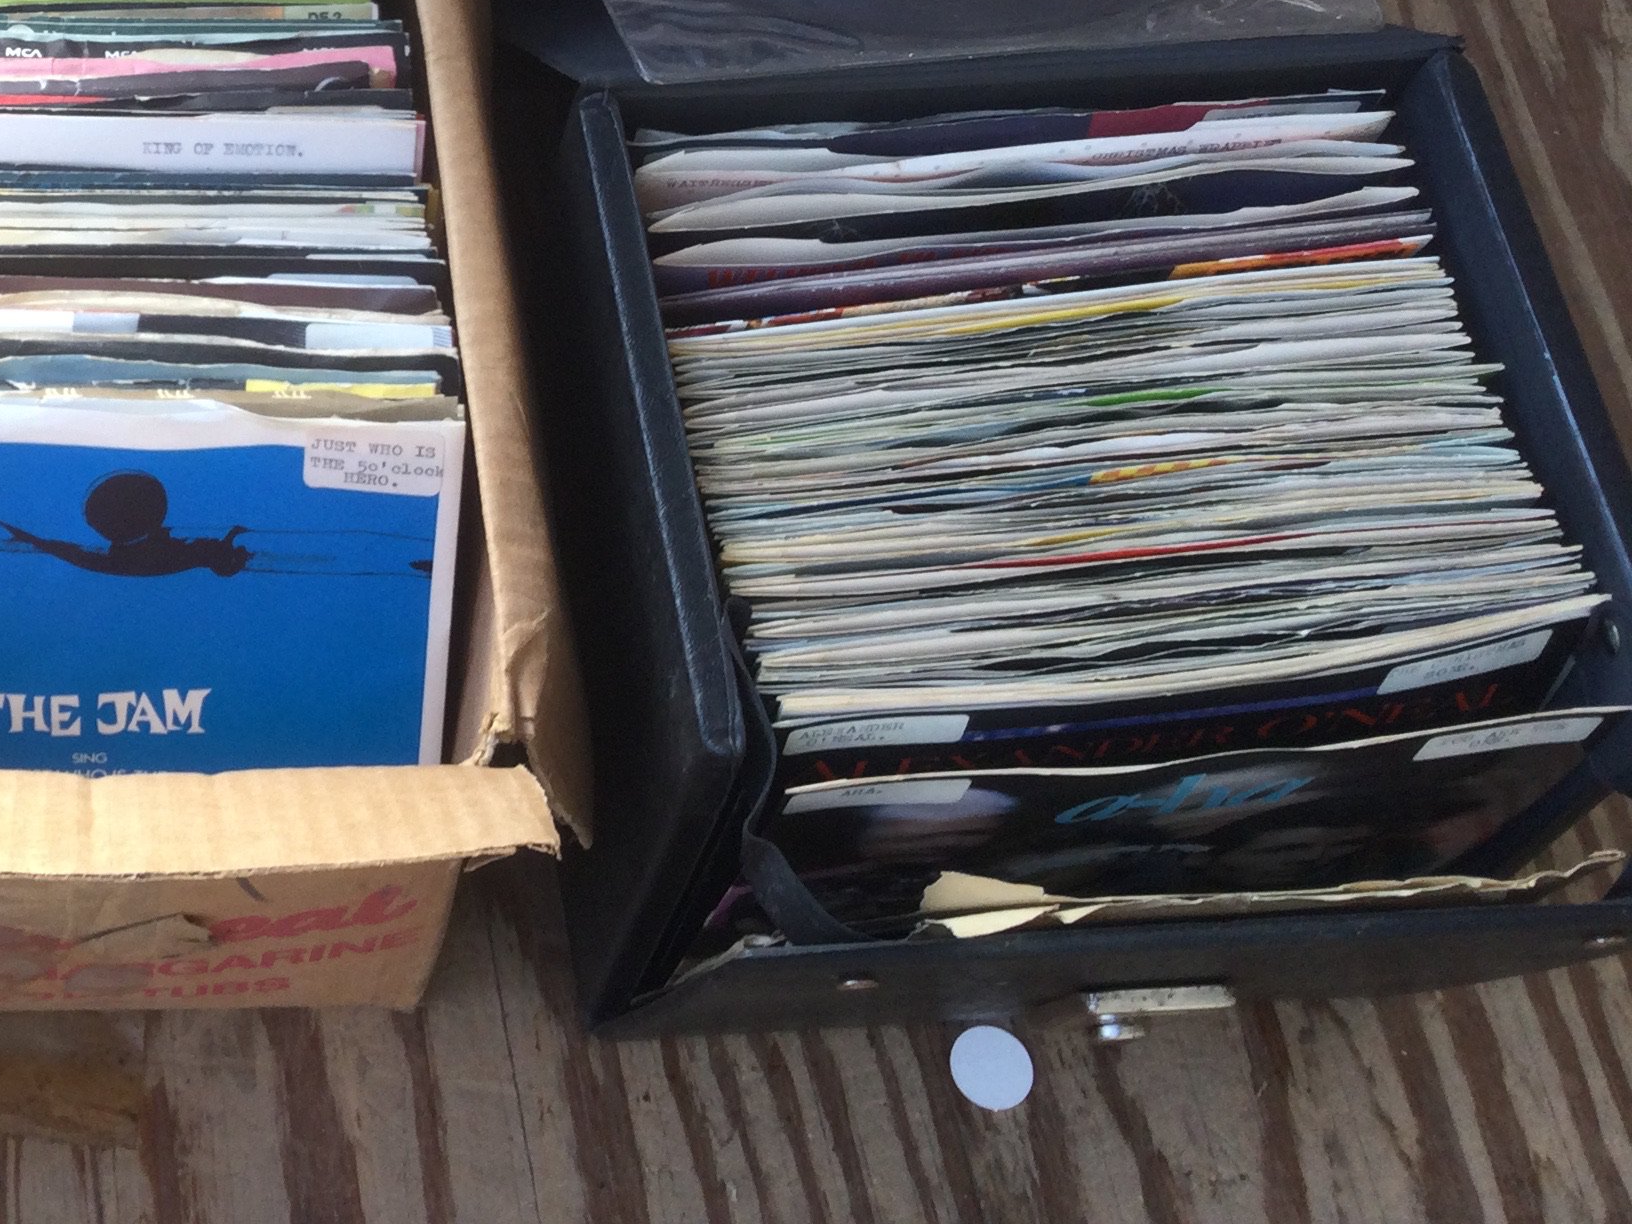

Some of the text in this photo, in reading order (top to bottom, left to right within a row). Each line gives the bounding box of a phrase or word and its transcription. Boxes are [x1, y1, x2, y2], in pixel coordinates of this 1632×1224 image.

[4, 46, 43, 58] MCA
[142, 141, 304, 158] KING OF EMOTION.
[310, 437, 437, 460] JUST WHO IS
[309, 456, 444, 478] THE 5o'clock
[343, 472, 398, 488] HERO.
[96, 687, 213, 736] JAM
[71, 752, 108, 765] SING
